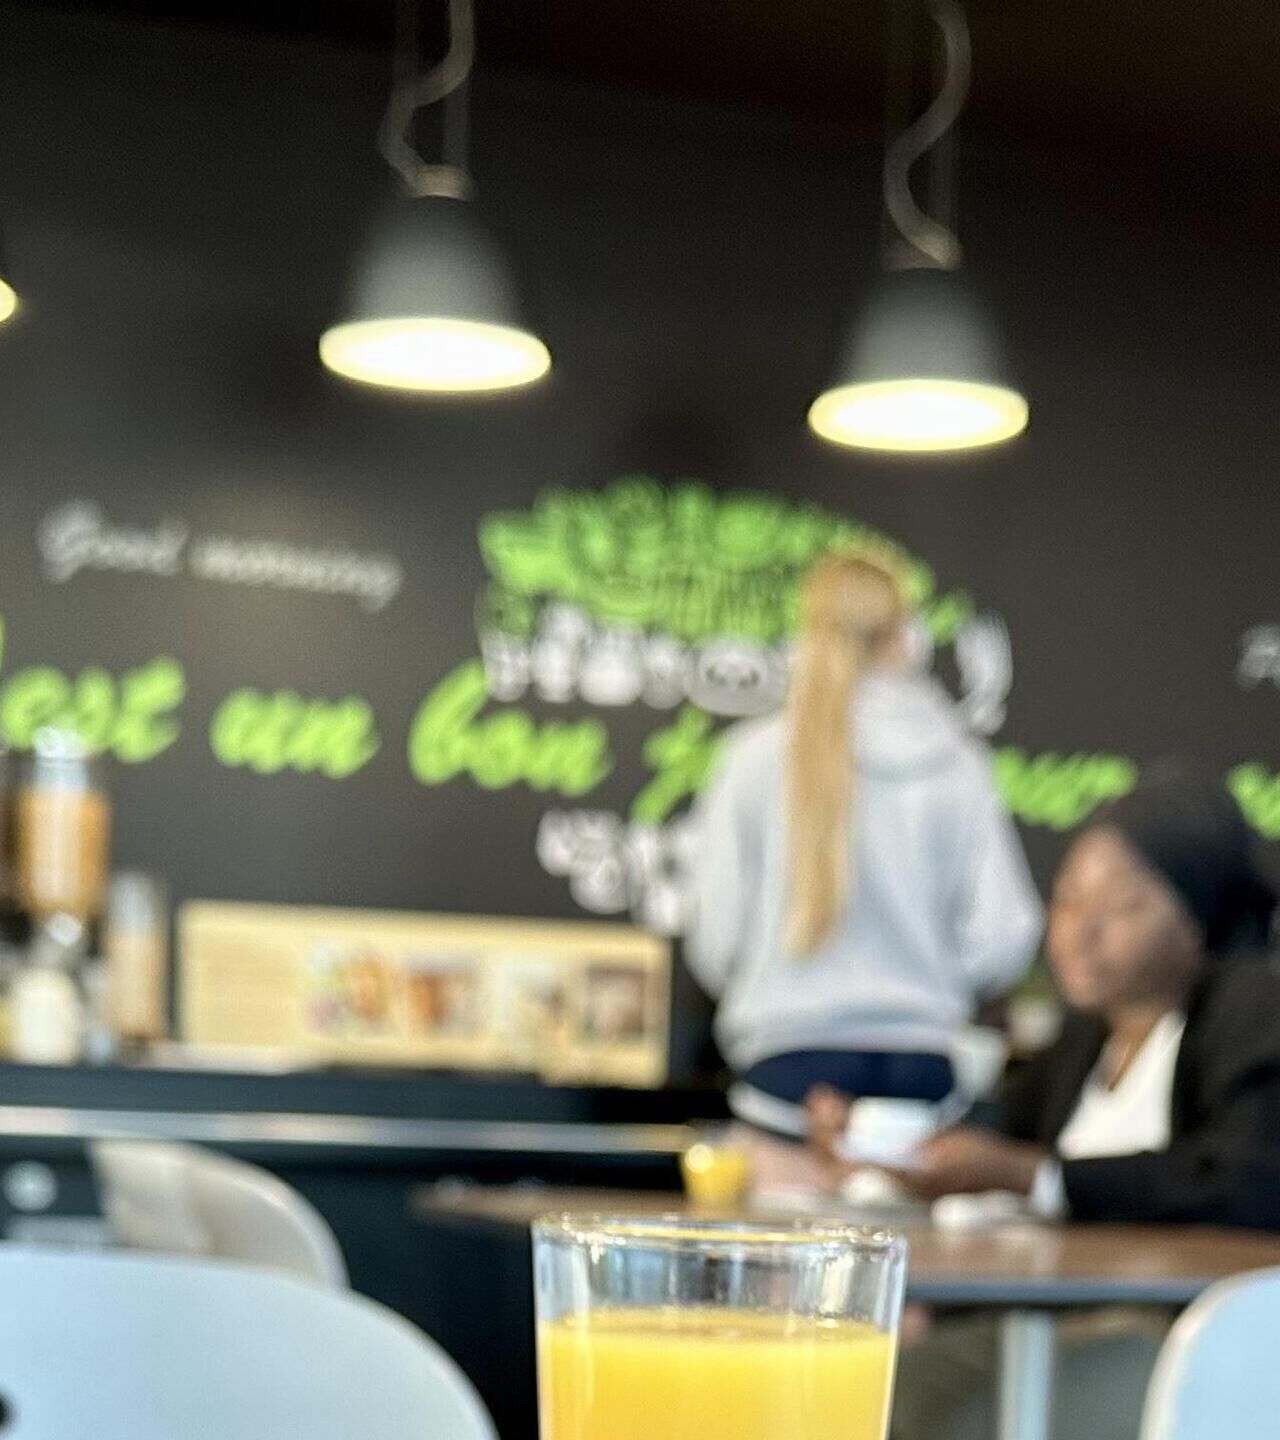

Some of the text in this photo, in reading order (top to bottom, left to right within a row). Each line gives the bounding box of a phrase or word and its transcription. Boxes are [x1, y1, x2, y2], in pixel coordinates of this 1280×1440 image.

[38, 502, 188, 582] Good
[209, 688, 380, 778] un
[407, 658, 615, 796] bon
